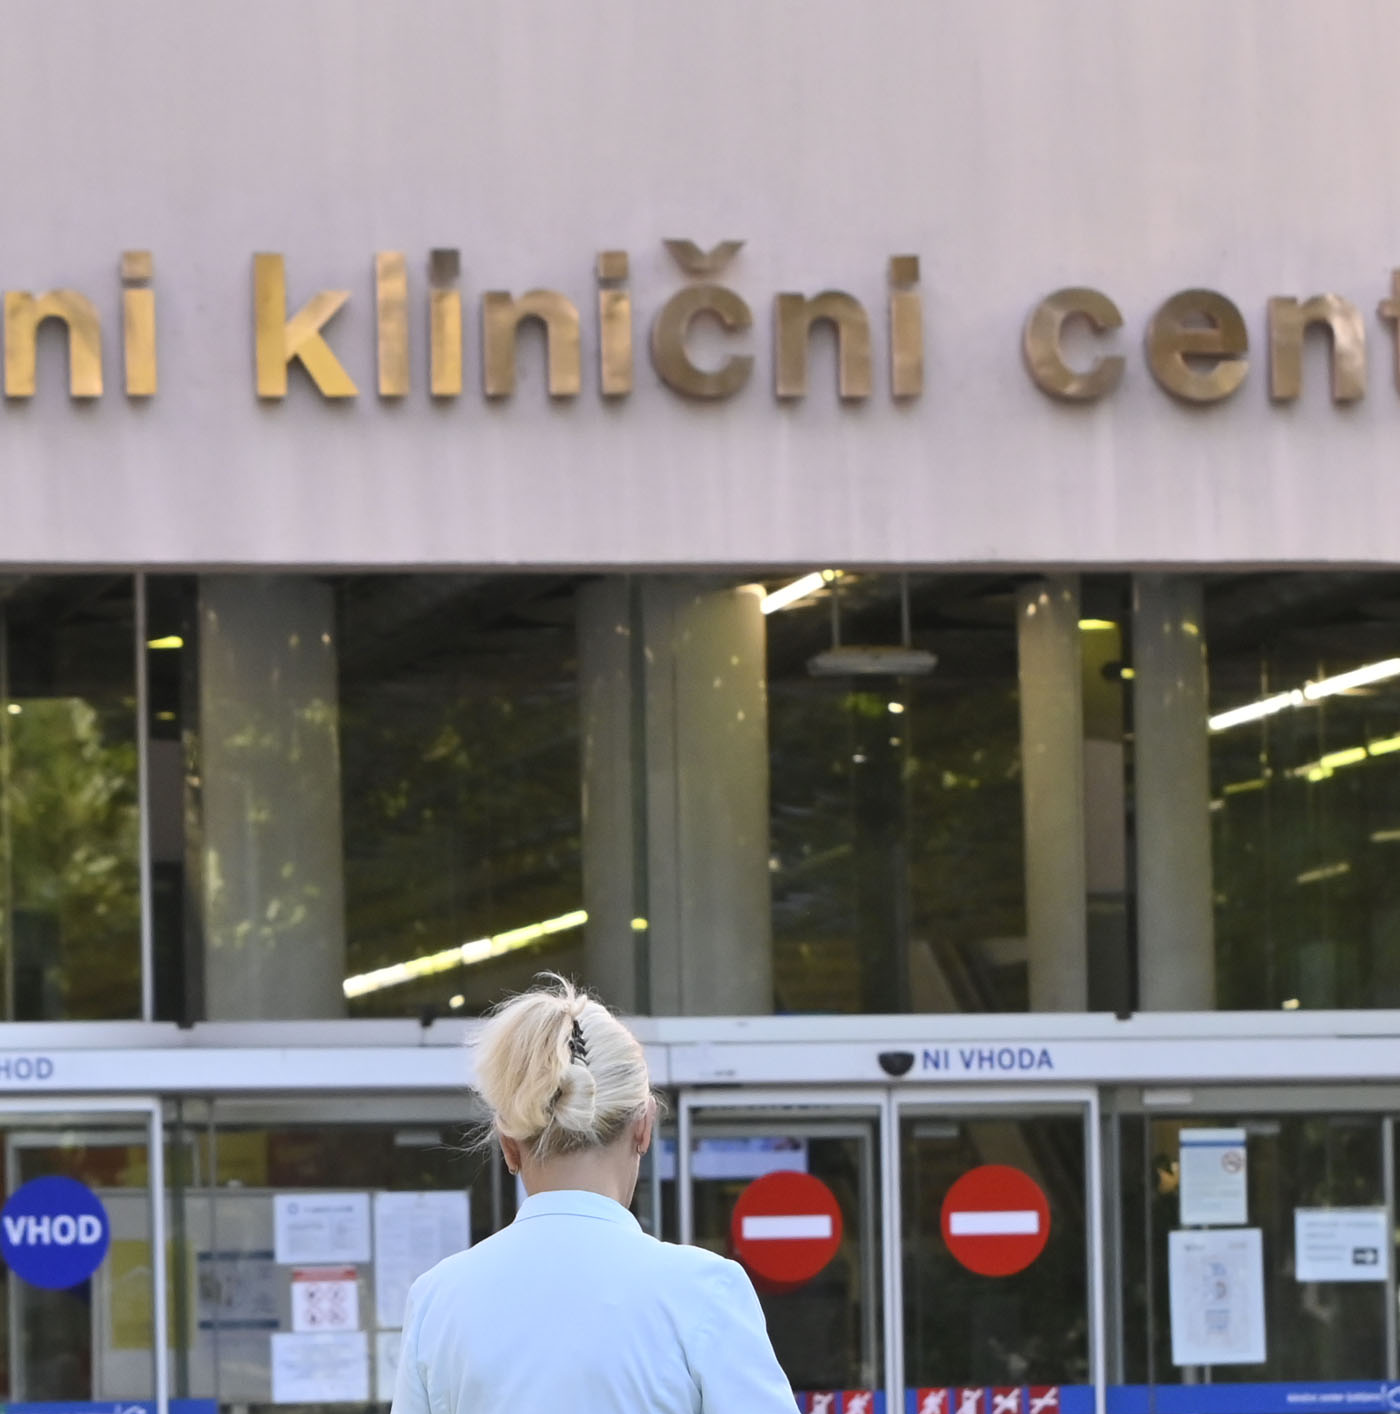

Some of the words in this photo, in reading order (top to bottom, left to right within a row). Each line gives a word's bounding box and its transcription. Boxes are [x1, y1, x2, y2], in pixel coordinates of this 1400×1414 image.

[252, 240, 923, 402] klinični
[922, 1048, 950, 1071] NI
[959, 1047, 1055, 1071] VHODA
[2, 1213, 103, 1247] VHOD
